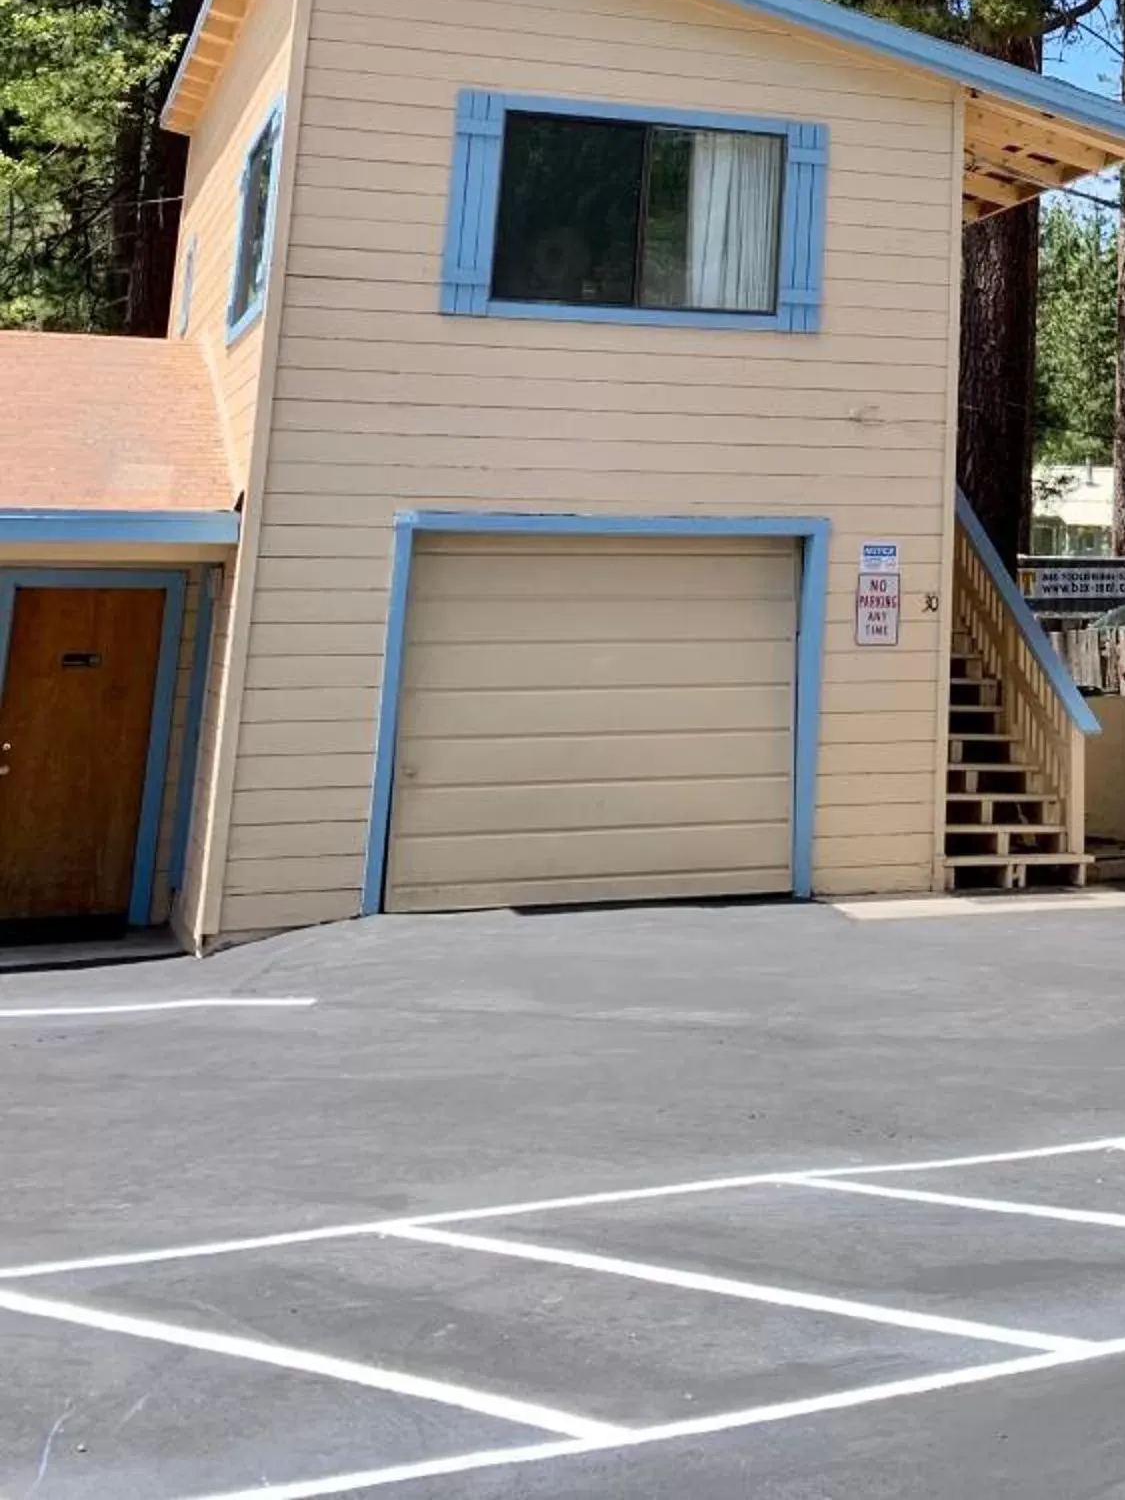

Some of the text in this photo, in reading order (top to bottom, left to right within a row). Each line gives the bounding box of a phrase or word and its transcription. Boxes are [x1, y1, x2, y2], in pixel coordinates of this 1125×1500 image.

[870, 580, 887, 592] NO
[860, 595, 897, 608] PARKING
[921, 594, 939, 612] 30
[868, 610, 887, 621] ANY
[865, 623, 888, 635] TIME
